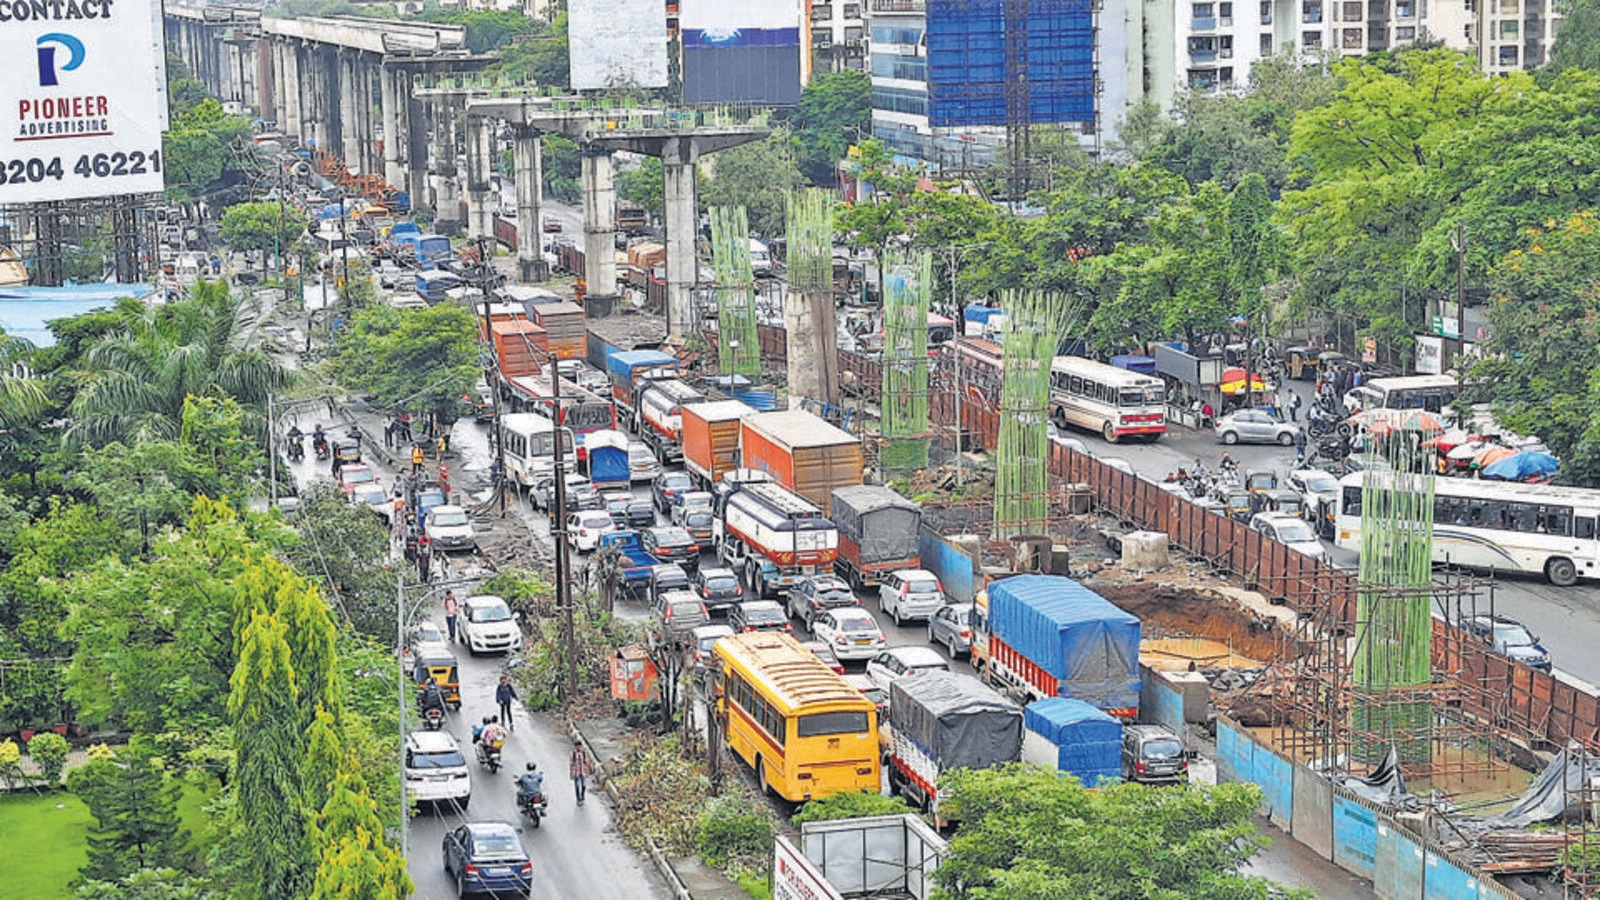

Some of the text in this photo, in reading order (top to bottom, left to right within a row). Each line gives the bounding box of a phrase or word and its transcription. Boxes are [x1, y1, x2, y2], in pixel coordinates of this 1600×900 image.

[0, 0, 113, 21] CONTACT
[19, 96, 108, 120] PIONEER
[20, 119, 107, 135] ADVERTISING
[74, 149, 160, 178] 46221
